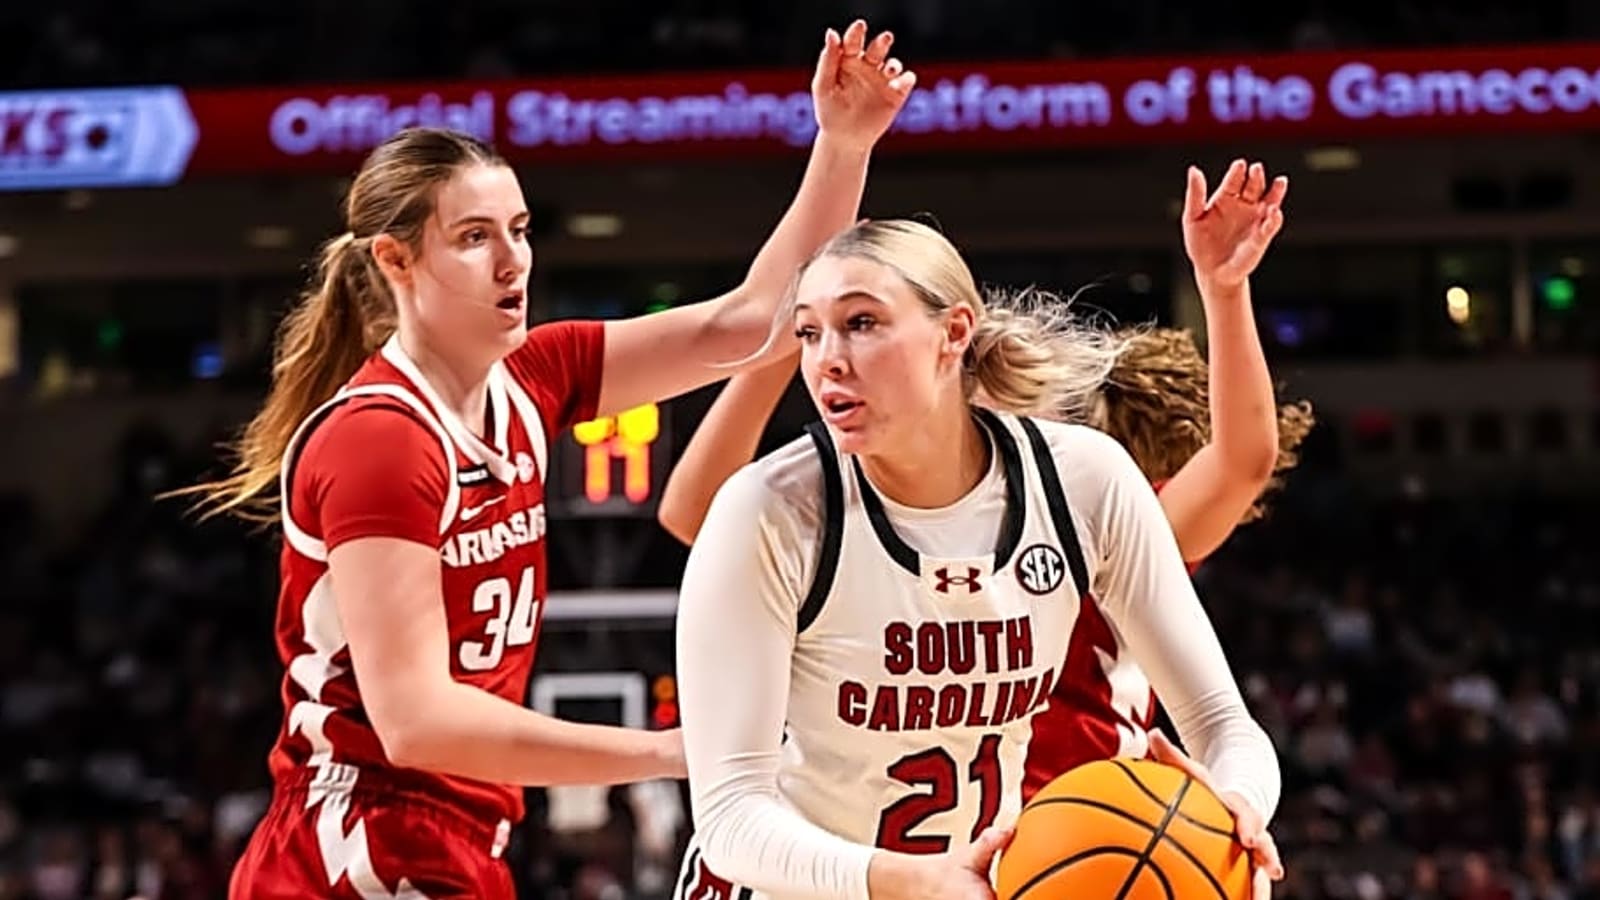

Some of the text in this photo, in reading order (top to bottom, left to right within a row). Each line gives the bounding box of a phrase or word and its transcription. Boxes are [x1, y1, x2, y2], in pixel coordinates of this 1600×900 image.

[268, 90, 495, 156] Official
[506, 82, 819, 147] Streaming
[1123, 65, 1196, 127] of
[1206, 64, 1315, 123] the
[1020, 547, 1062, 592] SEC
[459, 565, 540, 672] 34
[884, 614, 1034, 676] SOUTH
[875, 733, 1003, 856] 21
